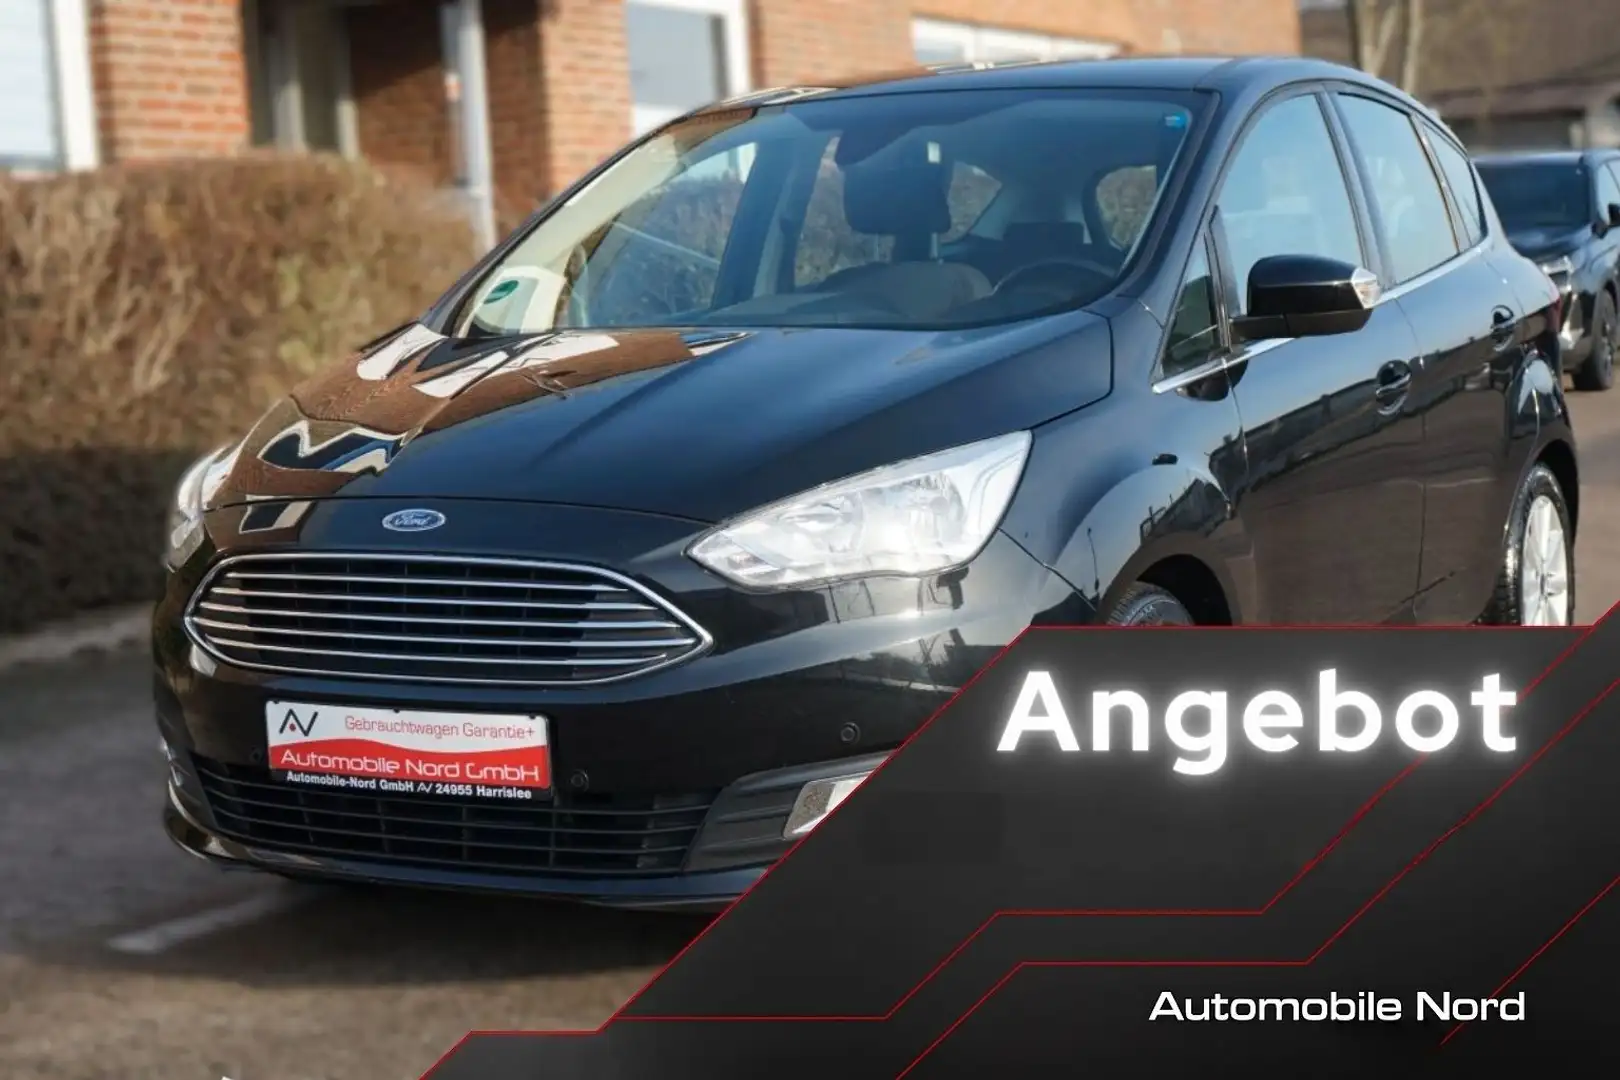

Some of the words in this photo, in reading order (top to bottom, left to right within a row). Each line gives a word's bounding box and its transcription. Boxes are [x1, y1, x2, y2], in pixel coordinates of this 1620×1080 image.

[345, 715, 459, 739] Gebrauchtwagen
[462, 723, 536, 740] Garantie+
[280, 749, 400, 775] Automobile
[404, 759, 460, 778] Nord
[465, 763, 540, 782] GmbH
[286, 770, 376, 790] Automobile-Nord
[380, 778, 415, 793] GmbH
[435, 784, 473, 796] 24955
[476, 786, 532, 800] Harrislee
